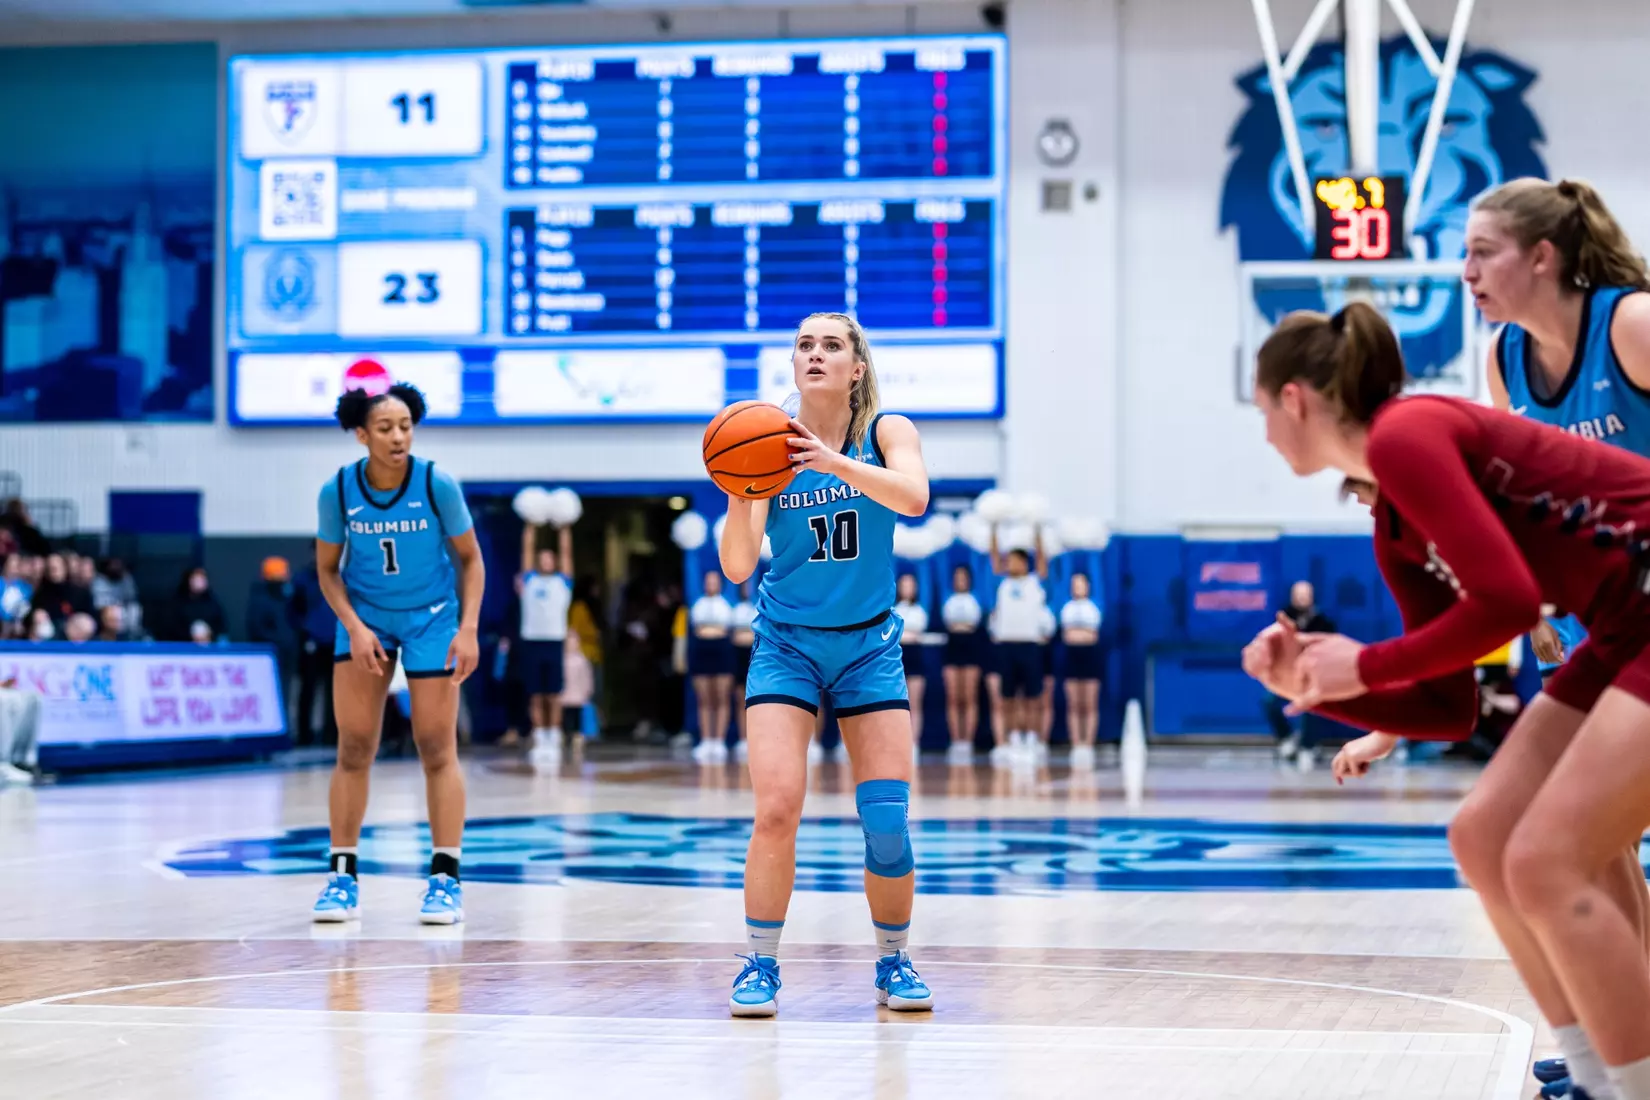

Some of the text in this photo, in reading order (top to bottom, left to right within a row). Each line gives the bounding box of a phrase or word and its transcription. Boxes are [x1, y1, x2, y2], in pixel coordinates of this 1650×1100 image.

[390, 91, 437, 124] 11
[1331, 207, 1390, 260] 30
[381, 271, 441, 304] 23
[778, 484, 867, 510] COLUMB
[350, 518, 428, 534] COLUMBIA
[808, 509, 860, 562] 10
[379, 538, 399, 575] 1
